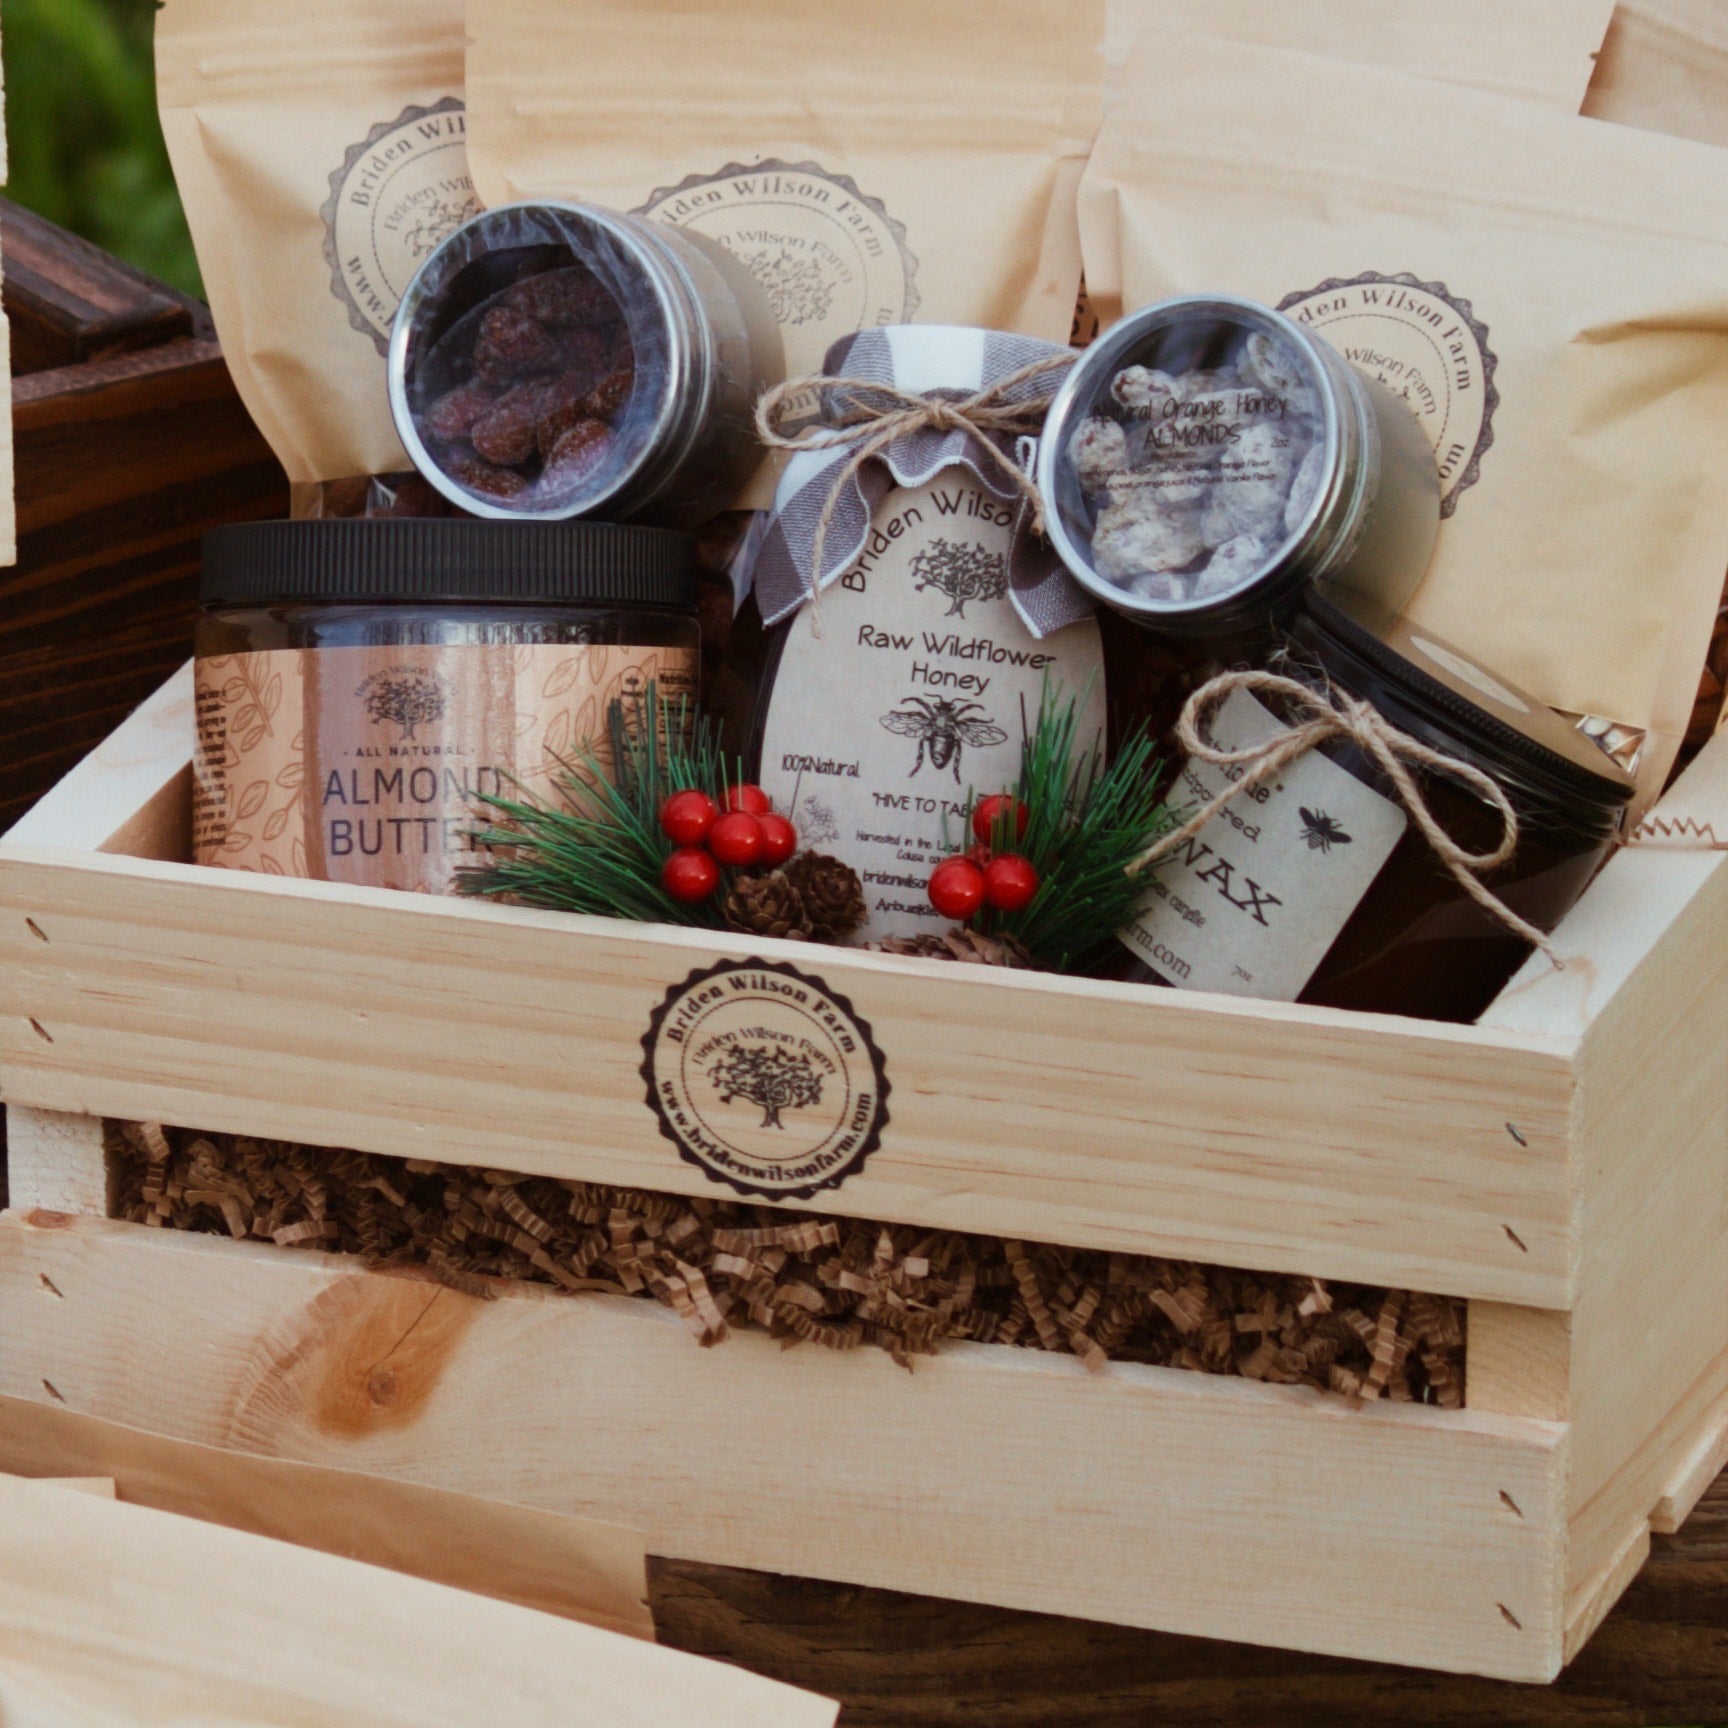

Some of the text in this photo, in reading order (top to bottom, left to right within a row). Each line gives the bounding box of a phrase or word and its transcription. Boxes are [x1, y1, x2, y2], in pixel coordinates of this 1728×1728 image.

[350, 116, 465, 207] Briden Wil
[383, 185, 437, 231] Briden
[662, 176, 884, 258] iden Wilson Farm
[735, 229, 807, 249] Wilson
[810, 240, 853, 285] Farm
[1298, 288, 1472, 391] den Wilson Farm
[1344, 347, 1438, 415] Wilson Farm
[1161, 397, 1226, 423] Orange
[1236, 393, 1288, 419] Honey
[1142, 422, 1243, 451] ALMONDS
[841, 489, 1016, 593] Briden Wilso
[857, 624, 1058, 670] Raw Wildflower
[910, 660, 991, 696] Honey
[355, 745, 465, 758] ALL NATURAL
[322, 765, 502, 806] ALMOND
[914, 796, 937, 814] TO
[665, 973, 857, 1055] Briden Wilson Farm
[690, 1025, 837, 1076] Briden Wilson Farm
[660, 1079, 873, 1182] www.bridenwilsonfarm.com
